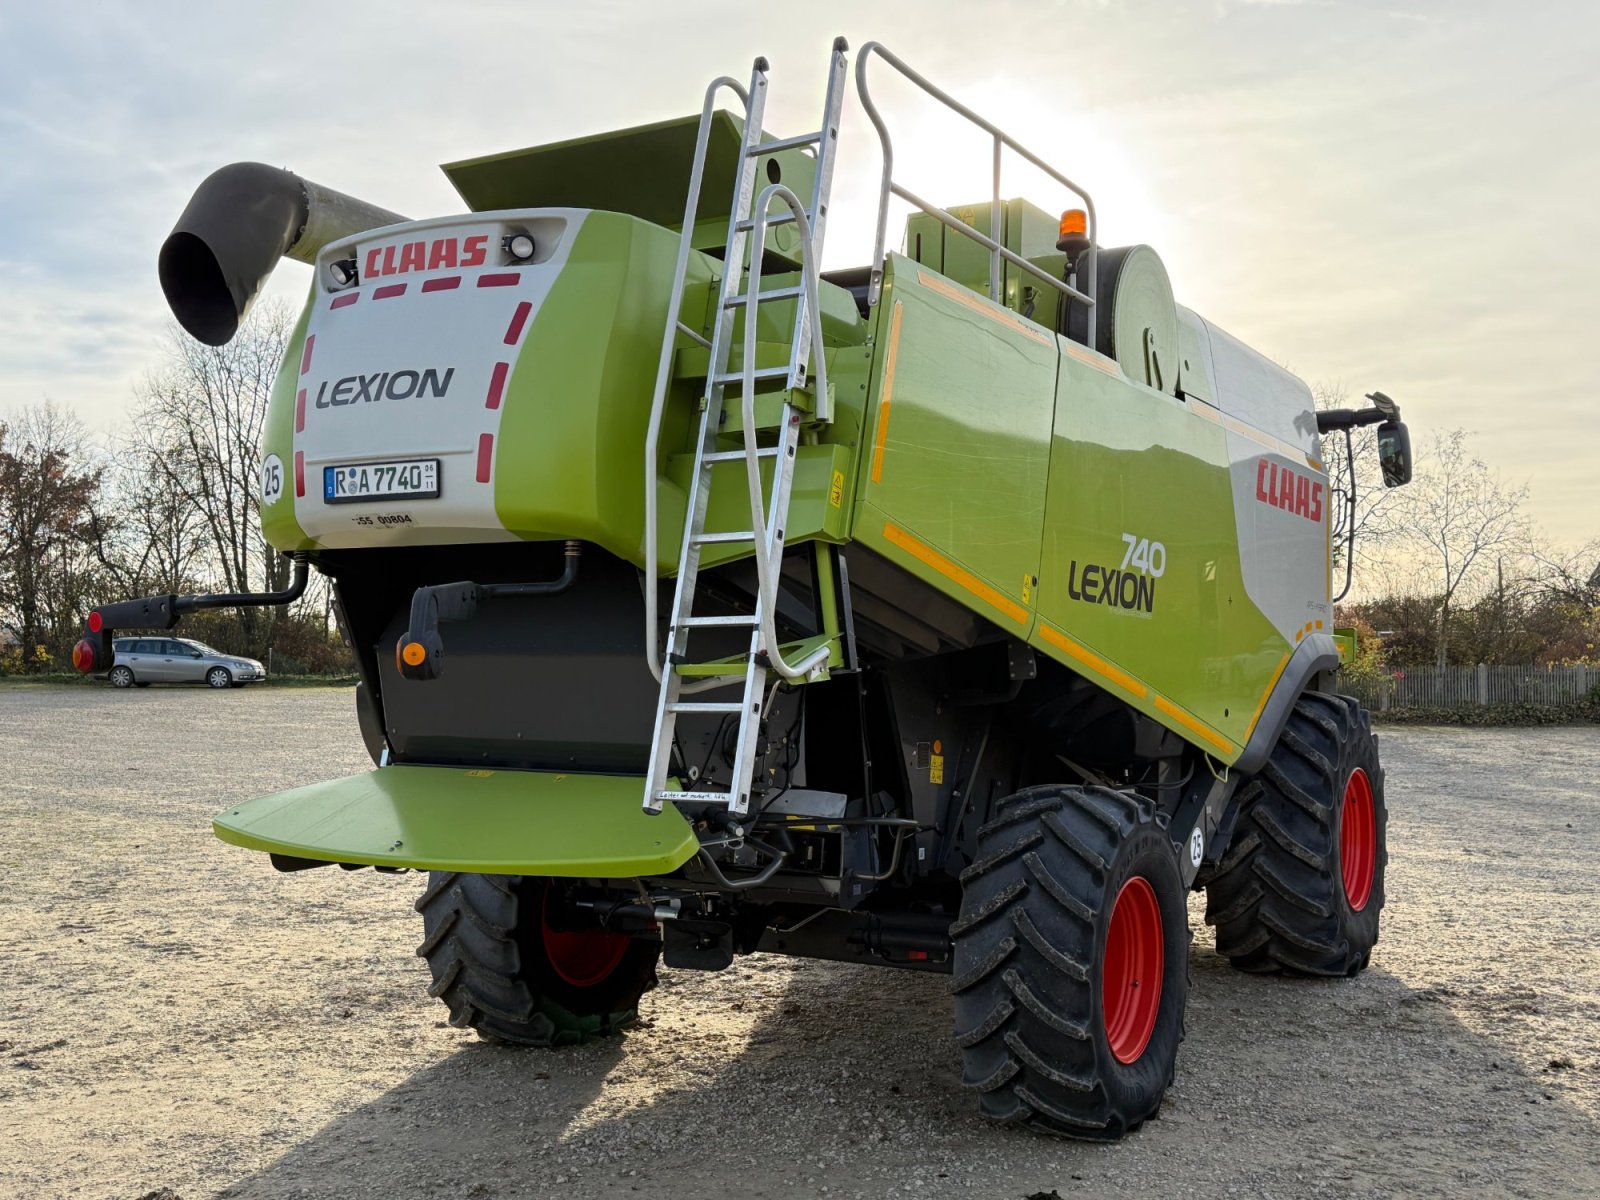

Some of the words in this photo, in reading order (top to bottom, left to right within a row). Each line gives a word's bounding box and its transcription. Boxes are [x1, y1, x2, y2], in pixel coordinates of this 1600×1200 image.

[364, 235, 489, 279] CLAAS
[315, 367, 455, 409] LEXION
[265, 465, 280, 496] 25
[335, 470, 346, 494] R
[1256, 459, 1323, 523] CLAAS
[1121, 532, 1166, 577] 740
[1068, 560, 1155, 613] LEXION
[1193, 834, 1202, 860] 25
